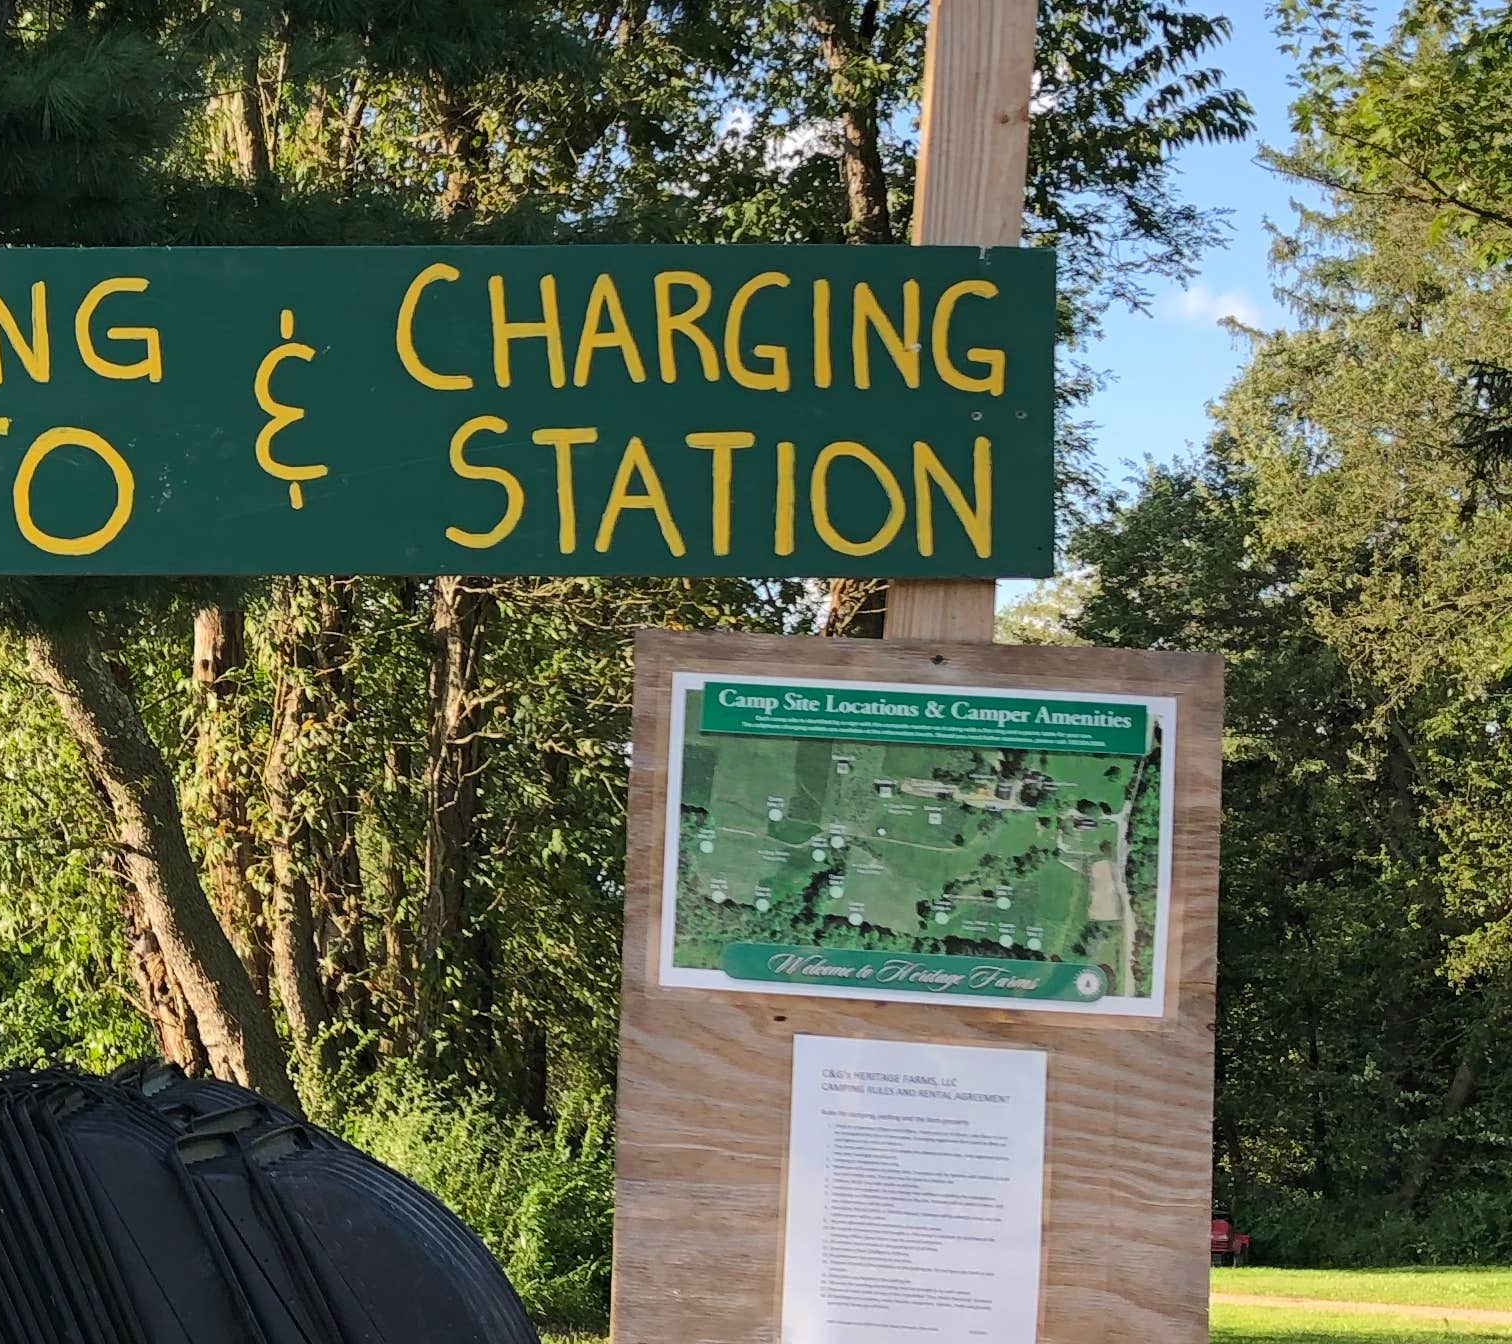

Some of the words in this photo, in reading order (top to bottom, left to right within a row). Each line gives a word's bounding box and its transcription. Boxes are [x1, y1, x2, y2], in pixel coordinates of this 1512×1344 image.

[255, 309, 328, 509] &
[397, 263, 1005, 395] CHARGING
[446, 415, 992, 557] STATION
[718, 688, 779, 716] Camp
[783, 692, 820, 712] Site
[824, 694, 919, 717] Locations
[924, 700, 945, 719] &
[950, 701, 1031, 727] Camper
[1035, 706, 1132, 728] Amenities
[768, 953, 857, 978] Welcome
[855, 964, 874, 979] to
[875, 959, 966, 992] Heritage
[968, 965, 1040, 990] Farms
